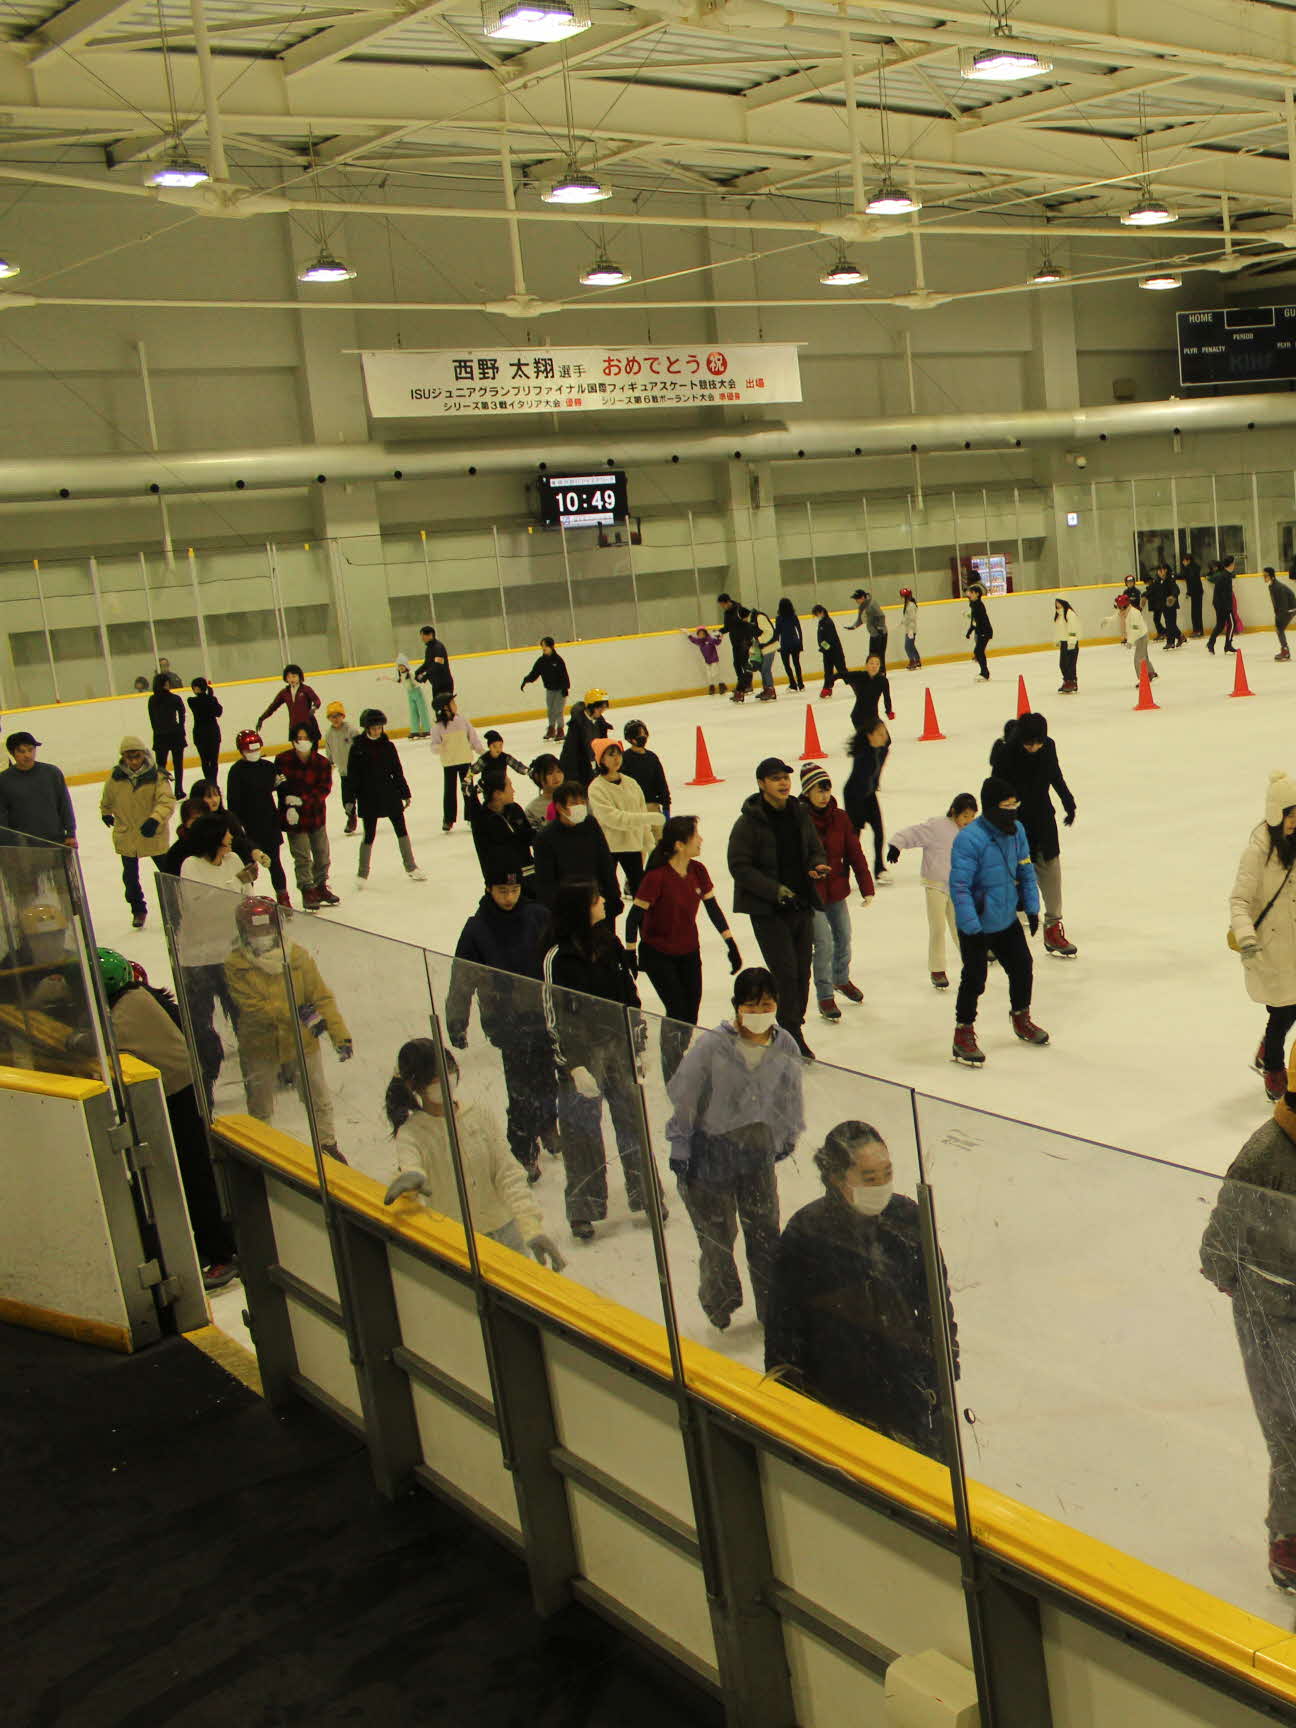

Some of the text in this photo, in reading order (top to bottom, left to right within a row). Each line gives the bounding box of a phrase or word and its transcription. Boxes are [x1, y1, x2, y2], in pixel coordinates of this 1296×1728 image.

[1189, 313, 1213, 323] HOME
[1201, 345, 1226, 353] PENALTY
[452, 358, 499, 381] 西野
[603, 355, 700, 376] おめでとう
[555, 490, 616, 512] 10:49
